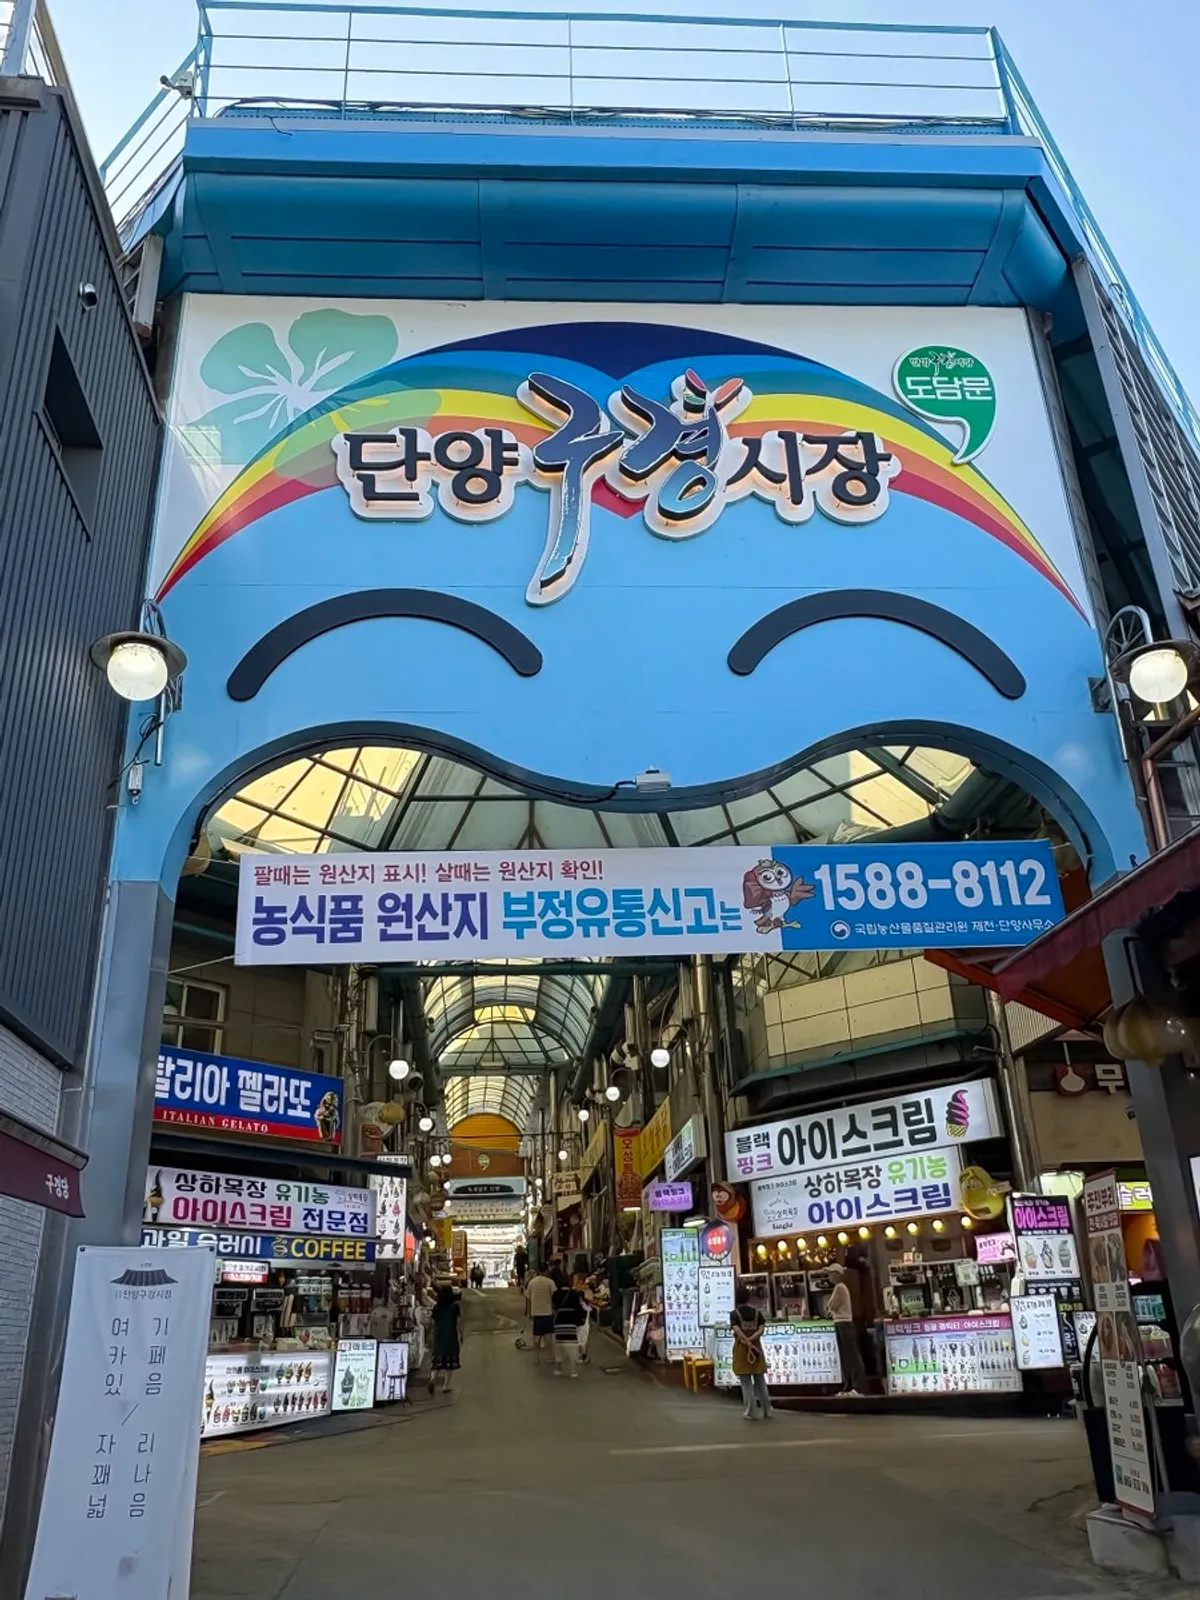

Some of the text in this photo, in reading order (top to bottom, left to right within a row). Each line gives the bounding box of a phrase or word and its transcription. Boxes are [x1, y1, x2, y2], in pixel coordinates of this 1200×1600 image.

[905, 376, 993, 401] 도담문
[341, 369, 891, 592] 단양구경시장
[253, 860, 604, 886] 팔때는 원산지 표시! 살때는 원산지 확인!
[813, 858, 1052, 912] 1588-8112
[251, 886, 743, 946] 농식품 원산지 부정유통신고는
[854, 921, 969, 936] 국립농산물품질관리원
[237, 1069, 312, 1119] 젤라또
[162, 1109, 269, 1134] ITALIAN GELATO
[735, 1132, 772, 1156] 블랙
[777, 1097, 939, 1167] 아이스크림
[736, 1152, 774, 1177] 핑크
[804, 1154, 948, 1199] 상하목장 유기농
[174, 1171, 268, 1200] 상하목장
[275, 1182, 330, 1206] 유기농
[171, 1196, 369, 1235] 아이스크림 전문점
[807, 1182, 952, 1226] 아이스크림
[1013, 1205, 1071, 1229] 아이스크림
[290, 1239, 366, 1261] COFFEE
[111, 1316, 169, 1337] 여기
[109, 1344, 166, 1366] 카페
[104, 1372, 163, 1397] 있음
[96, 1432, 155, 1455] 자리
